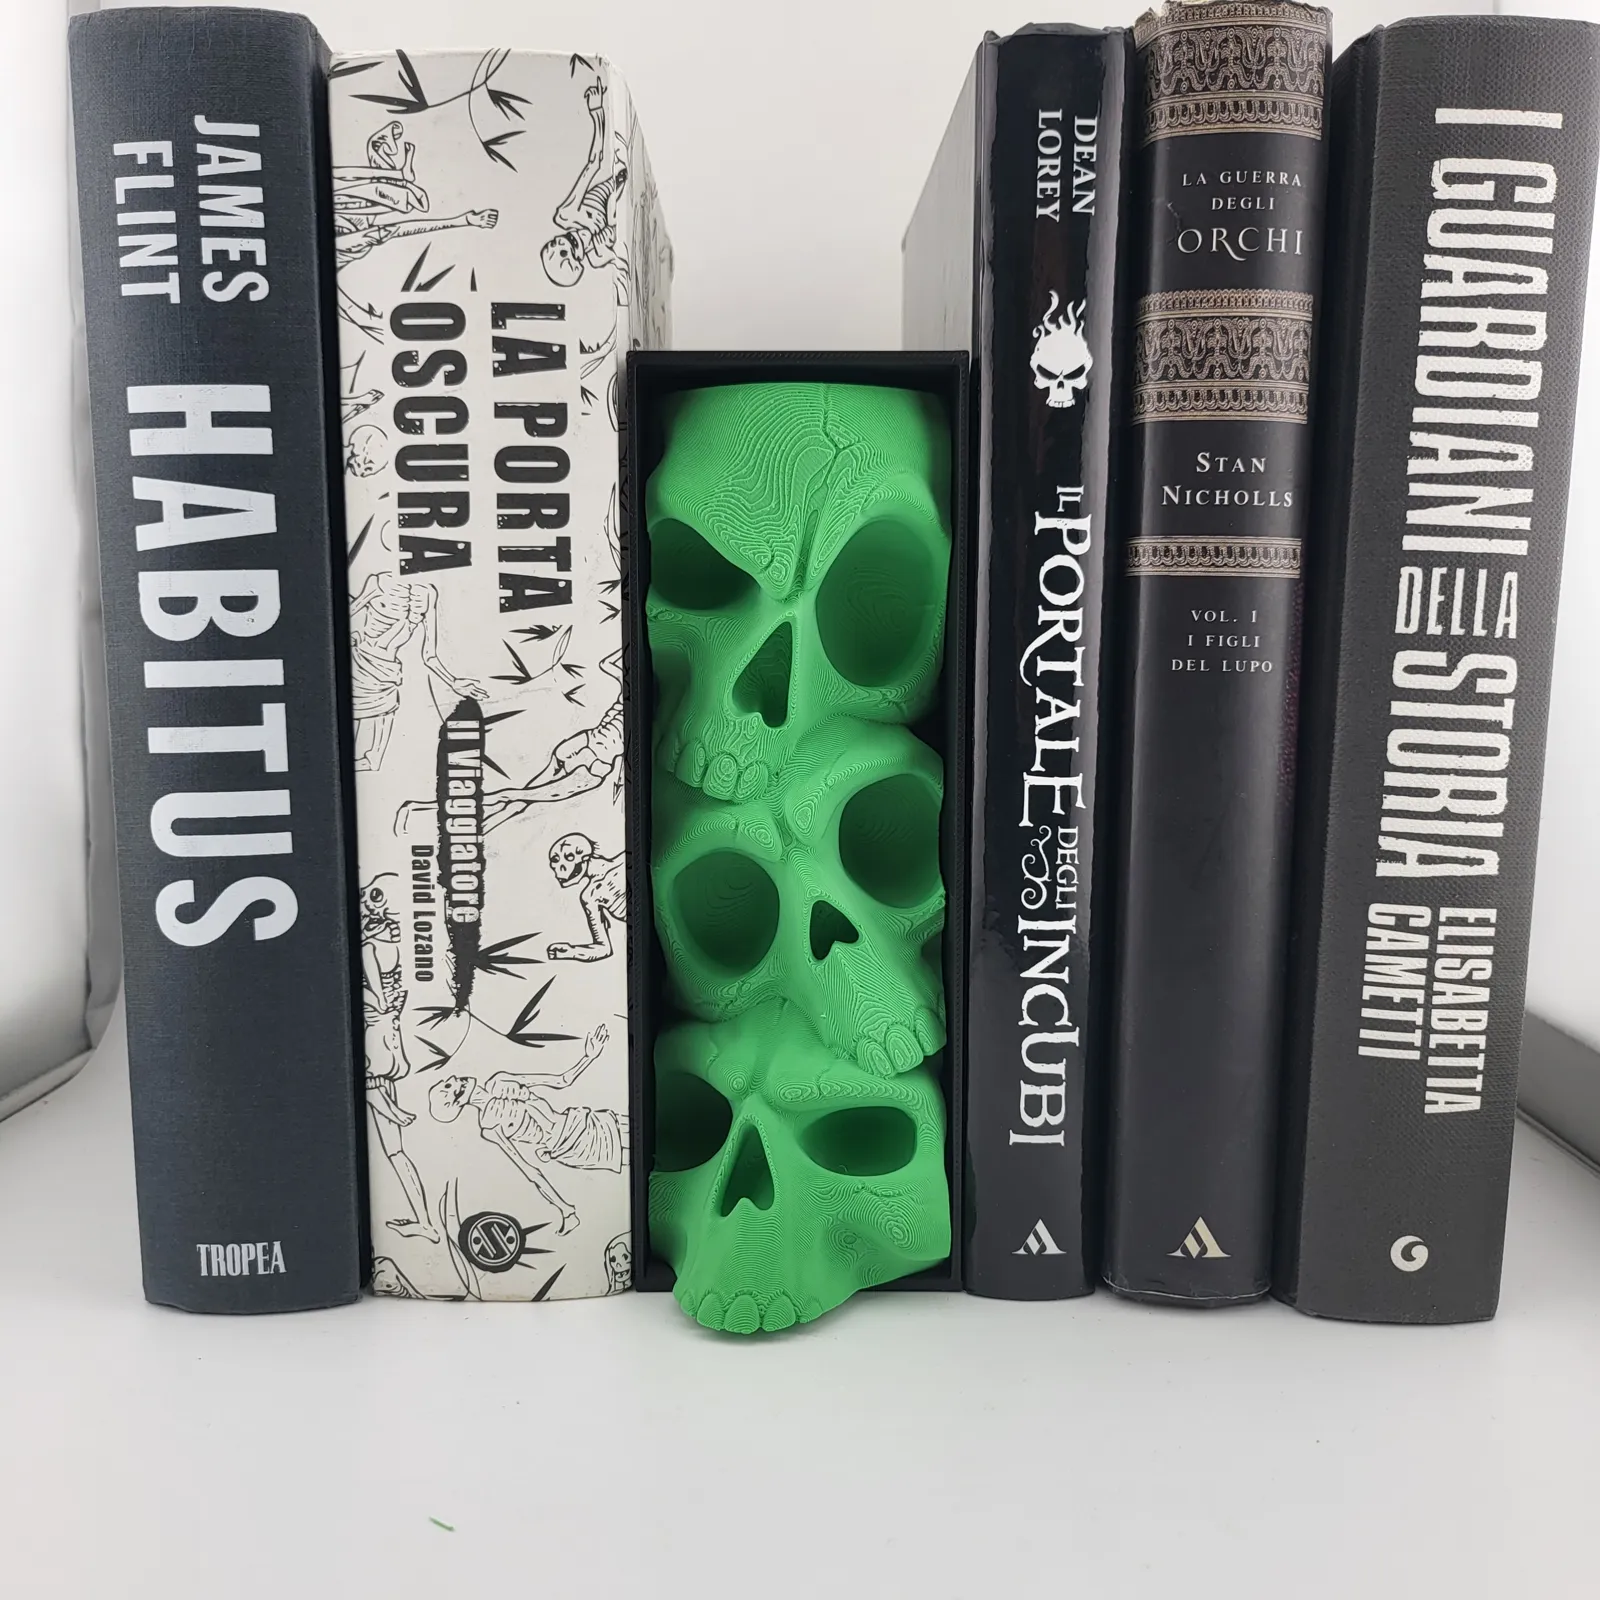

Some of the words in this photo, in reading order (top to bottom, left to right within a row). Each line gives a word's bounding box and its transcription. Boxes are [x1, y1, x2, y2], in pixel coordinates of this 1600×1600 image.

[1435, 108, 1563, 129] I
[1037, 110, 1062, 222] LOREY
[1073, 117, 1097, 215] DEAN
[1182, 173, 1207, 187] LA
[1219, 170, 1302, 187] GUERRA
[1211, 197, 1275, 210] DEGLI
[113, 141, 180, 303] FLINT
[194, 115, 269, 302] JAMES
[1177, 227, 1303, 261] ORCHI
[491, 303, 566, 377] LA
[1402, 158, 1557, 556] GUARDIANI
[390, 303, 471, 575] OSCURA
[494, 402, 572, 613] PORTA
[1057, 486, 1083, 511] IL
[1187, 634, 1194, 647] I
[1205, 635, 1260, 648] FIGLI
[1191, 609, 1238, 623] VOL.
[1395, 566, 1518, 639] DELLA
[127, 384, 298, 947] HABITUS
[1019, 511, 1092, 827] PORTALE
[1171, 659, 1210, 672] DEL
[1222, 660, 1273, 673] LUPO
[447, 720, 480, 740] Il
[1376, 650, 1518, 877] STORIA
[412, 846, 435, 903] David
[445, 749, 481, 923] Viaggiatore
[1056, 826, 1079, 908] DEGLI
[414, 911, 435, 981] Lozano
[1358, 903, 1432, 1060] CAMETTI
[1010, 915, 1079, 1146] INCUBI
[1424, 906, 1497, 1114] ELISABETTA
[196, 1241, 286, 1276] TROPEA
